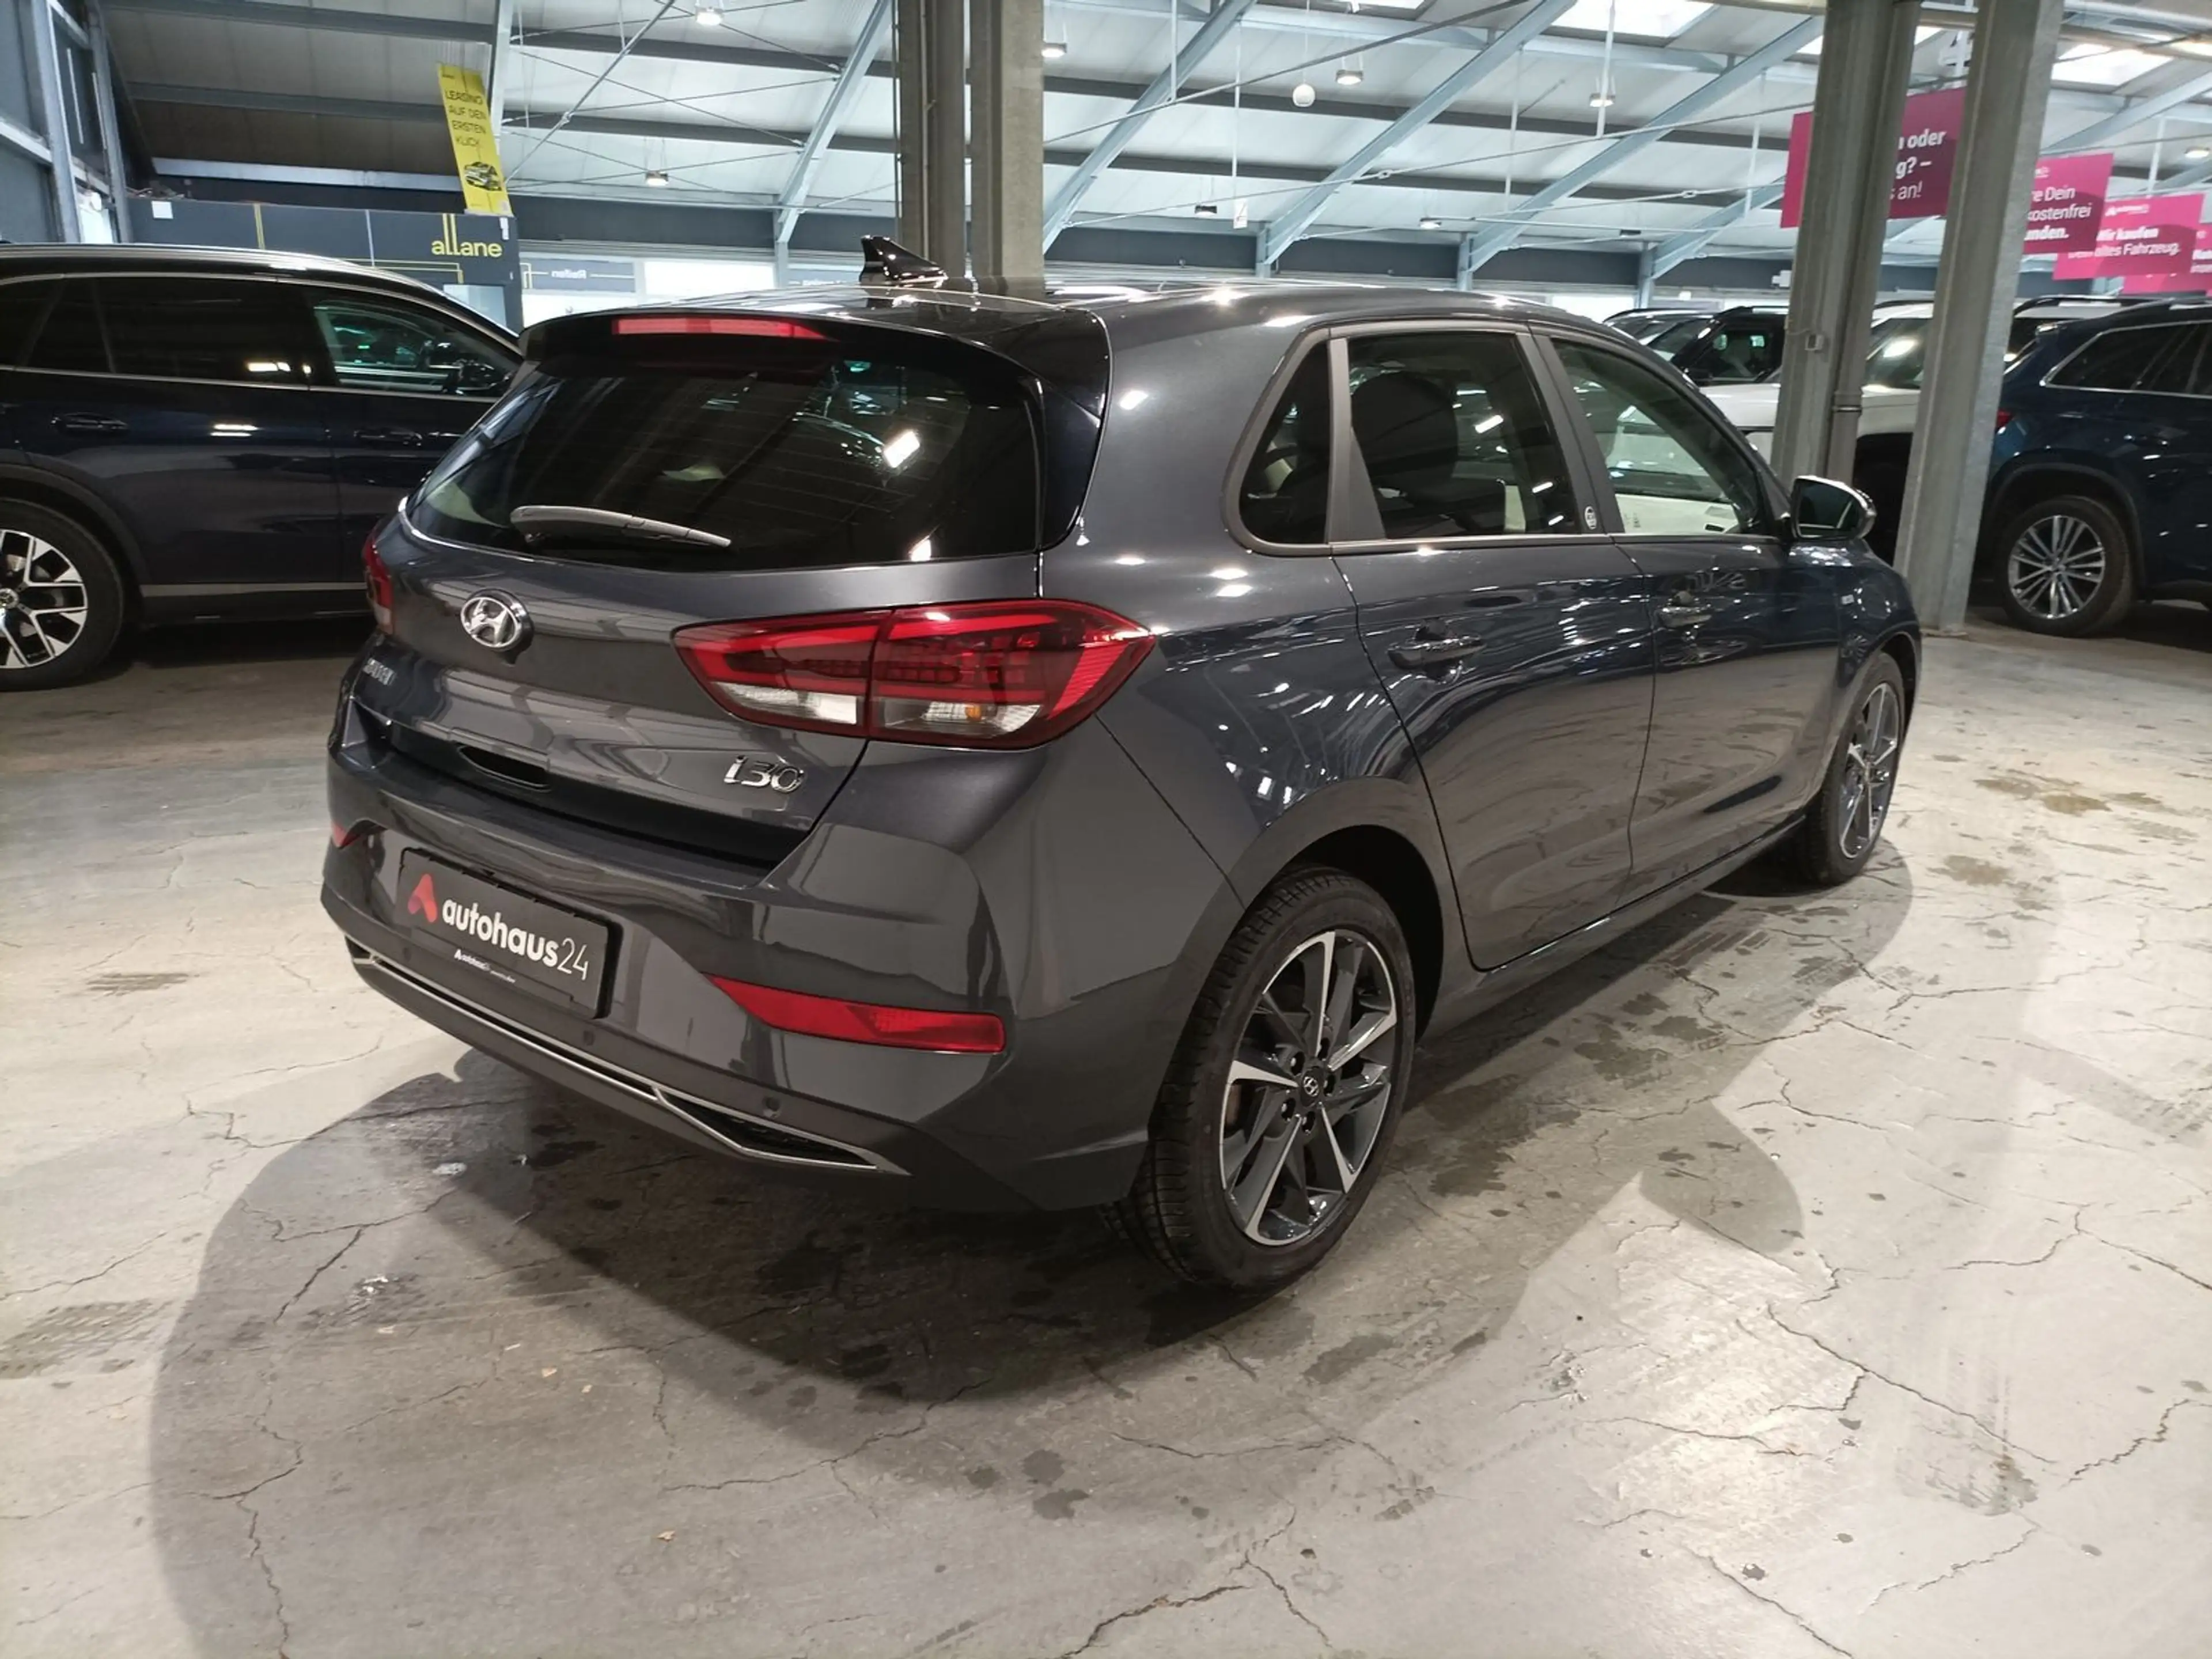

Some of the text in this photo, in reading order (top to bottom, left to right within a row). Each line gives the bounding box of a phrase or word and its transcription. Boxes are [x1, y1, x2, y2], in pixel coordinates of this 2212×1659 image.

[1907, 128, 1946, 149] oder
[1897, 180, 1923, 200] an!
[2045, 184, 2075, 202] Dein
[431, 214, 503, 257] allane
[724, 755, 804, 794] i30
[442, 899, 589, 980] autohaus24
